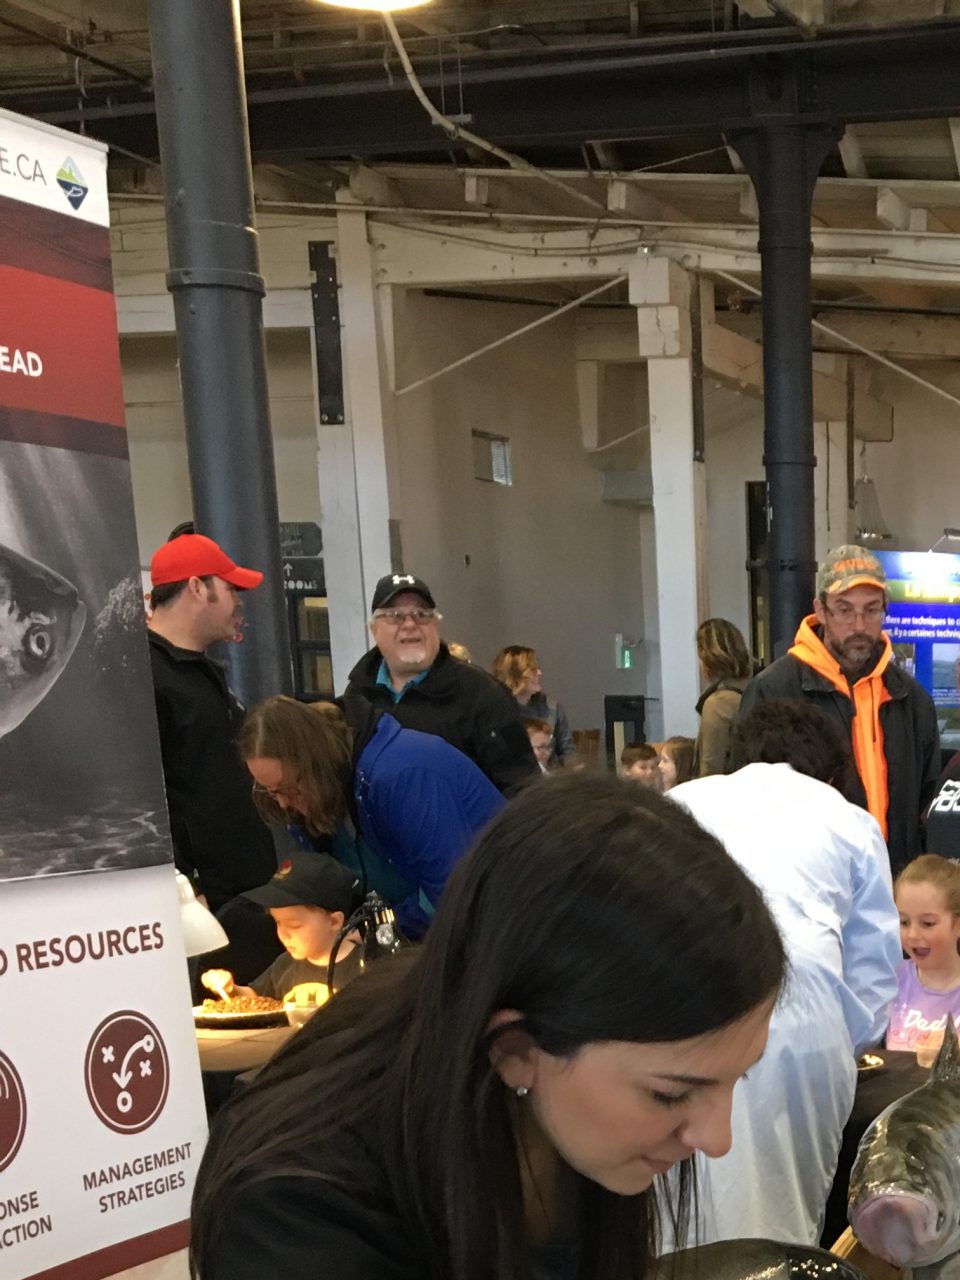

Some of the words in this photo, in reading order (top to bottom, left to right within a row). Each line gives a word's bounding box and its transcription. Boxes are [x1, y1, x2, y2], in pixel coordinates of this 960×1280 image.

[16, 921, 164, 974] RESOURCES
[82, 1142, 192, 1191] MANAGEMENT
[99, 1170, 186, 1214] STRATEGIES
[0, 1214, 52, 1250] CTION
